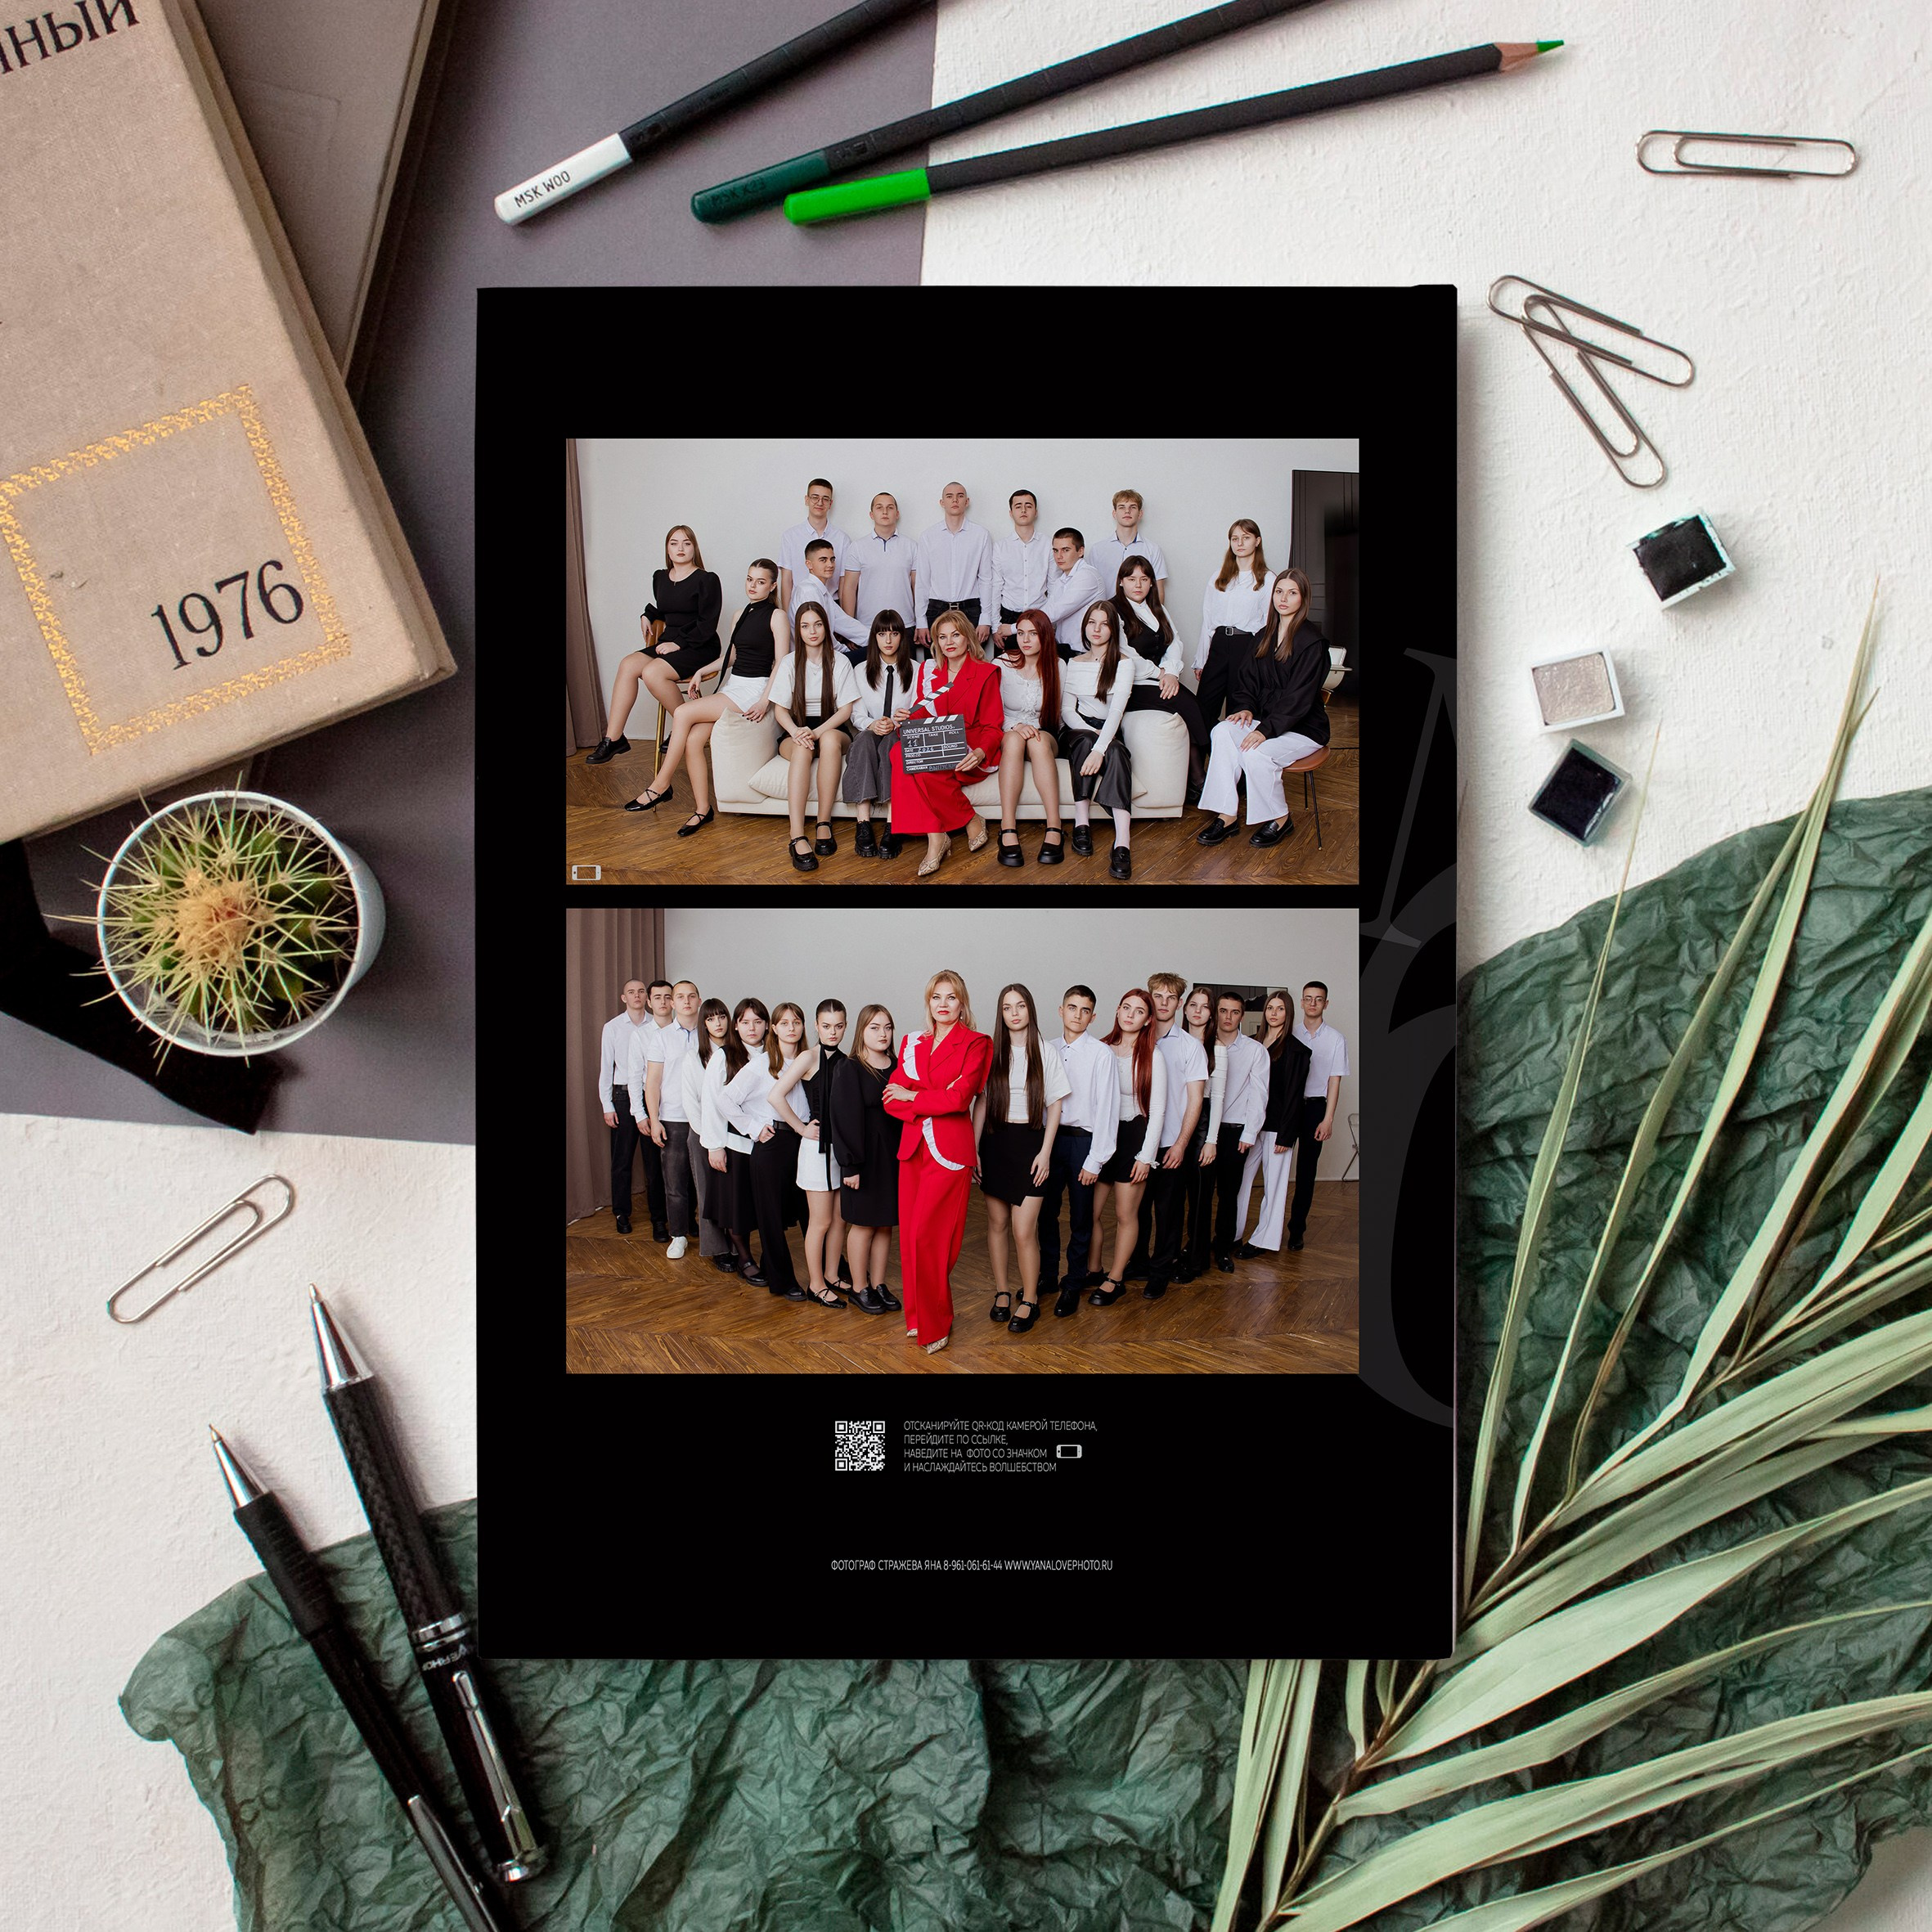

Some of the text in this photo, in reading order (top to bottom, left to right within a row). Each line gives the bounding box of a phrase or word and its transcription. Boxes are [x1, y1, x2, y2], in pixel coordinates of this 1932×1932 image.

[514, 185, 543, 208] MSK
[151, 559, 304, 671] 1976
[904, 1418, 1097, 1431] ОТСКАНИРУЙТЕ QR-КОД КАМЕРОЙ ТЕЛЕФОНА,
[905, 1432, 1008, 1445] ПЕРЕЙДИТЕ ПО ССЫЛКЕ,
[905, 1449, 1047, 1459] НАВЕДИТЕ НА ФОТО СО ЗНАЧКОМ
[905, 1460, 1057, 1473] И НАСЛАЖДАЙТЕСЬ ВОЛШЕБСТВОМ
[831, 1560, 1113, 1570] ФОТОГРАФ СТРАЖЕВА ЯНА 8-961-061-61-44 WWW.YANALOVEPHOTO.RU
